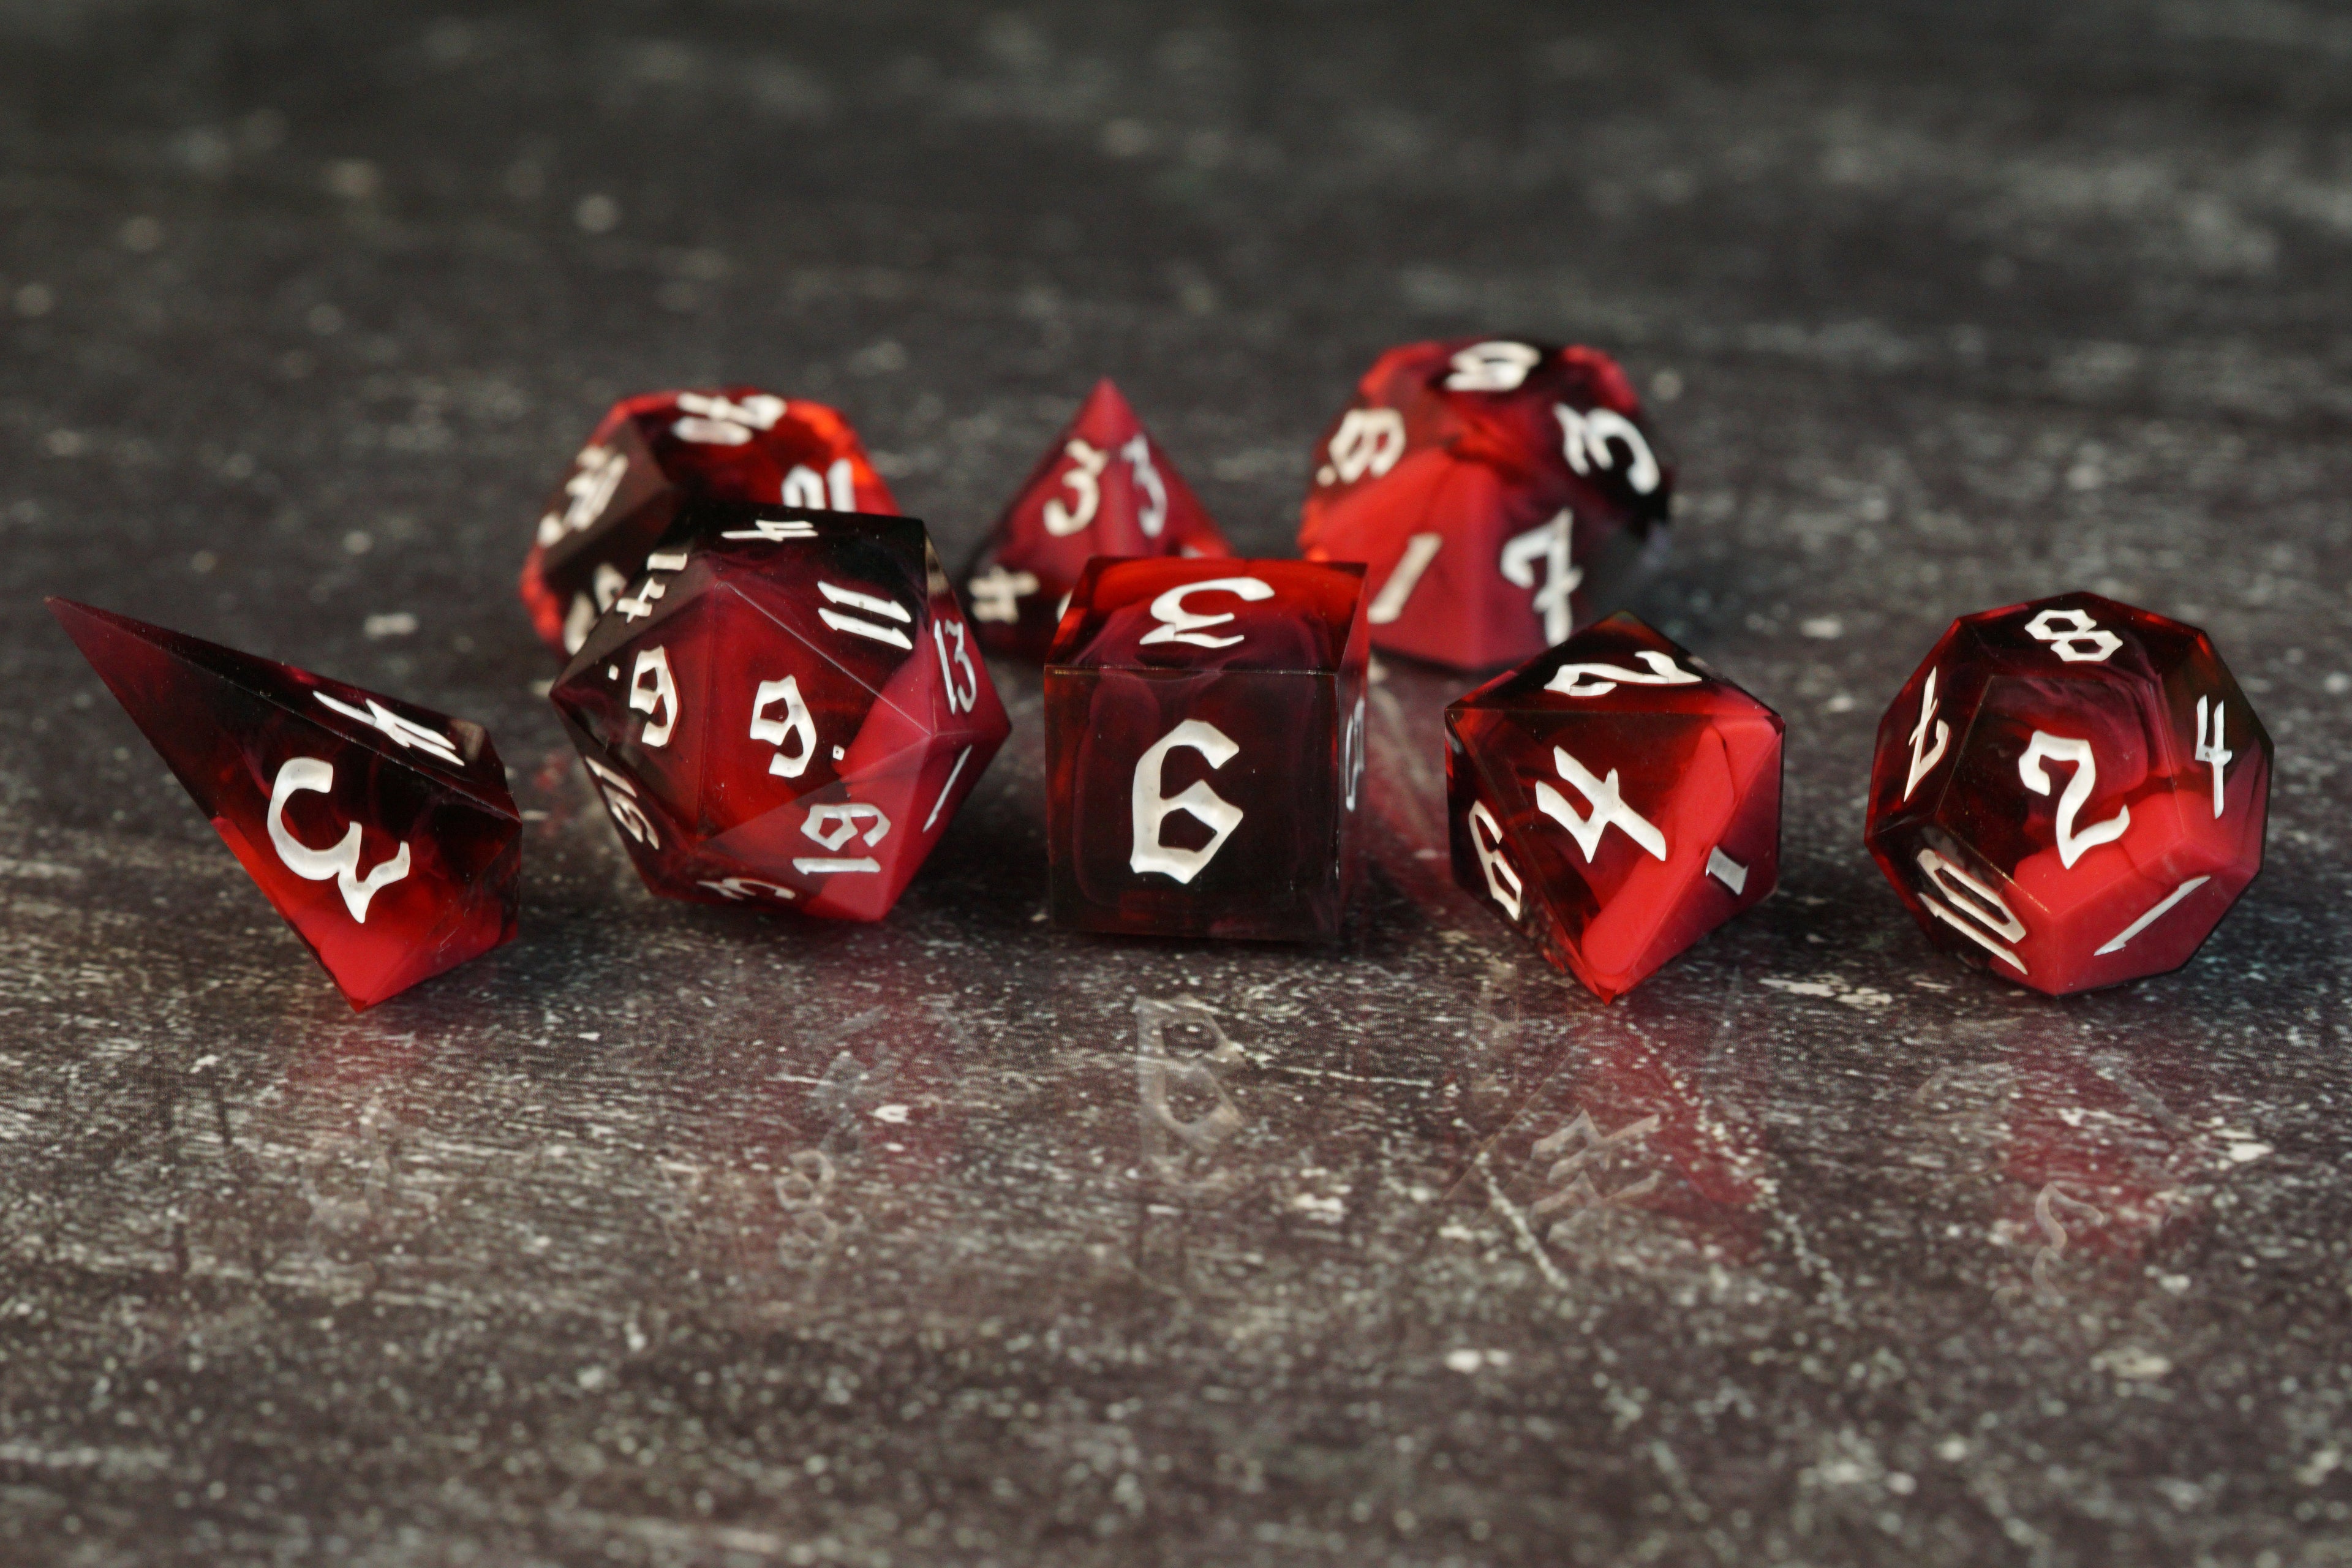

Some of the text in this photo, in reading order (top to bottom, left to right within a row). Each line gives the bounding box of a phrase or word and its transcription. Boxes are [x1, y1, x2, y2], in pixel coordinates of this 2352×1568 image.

[1044, 440, 1107, 537] 3
[816, 581, 913, 650] 11
[970, 567, 1038, 622] 4
[1139, 576, 1275, 649] 3
[2024, 608, 2124, 663] 8
[933, 619, 977, 715] 13
[1543, 650, 1703, 697] 2
[312, 690, 466, 766] 4
[2194, 694, 2233, 820] 4
[1129, 719, 1244, 885] 6
[1534, 745, 1667, 864] 4
[2018, 730, 2131, 870] 2
[1469, 801, 1523, 921] 6
[1917, 849, 2028, 976] 10
[2093, 875, 2211, 957] 1
